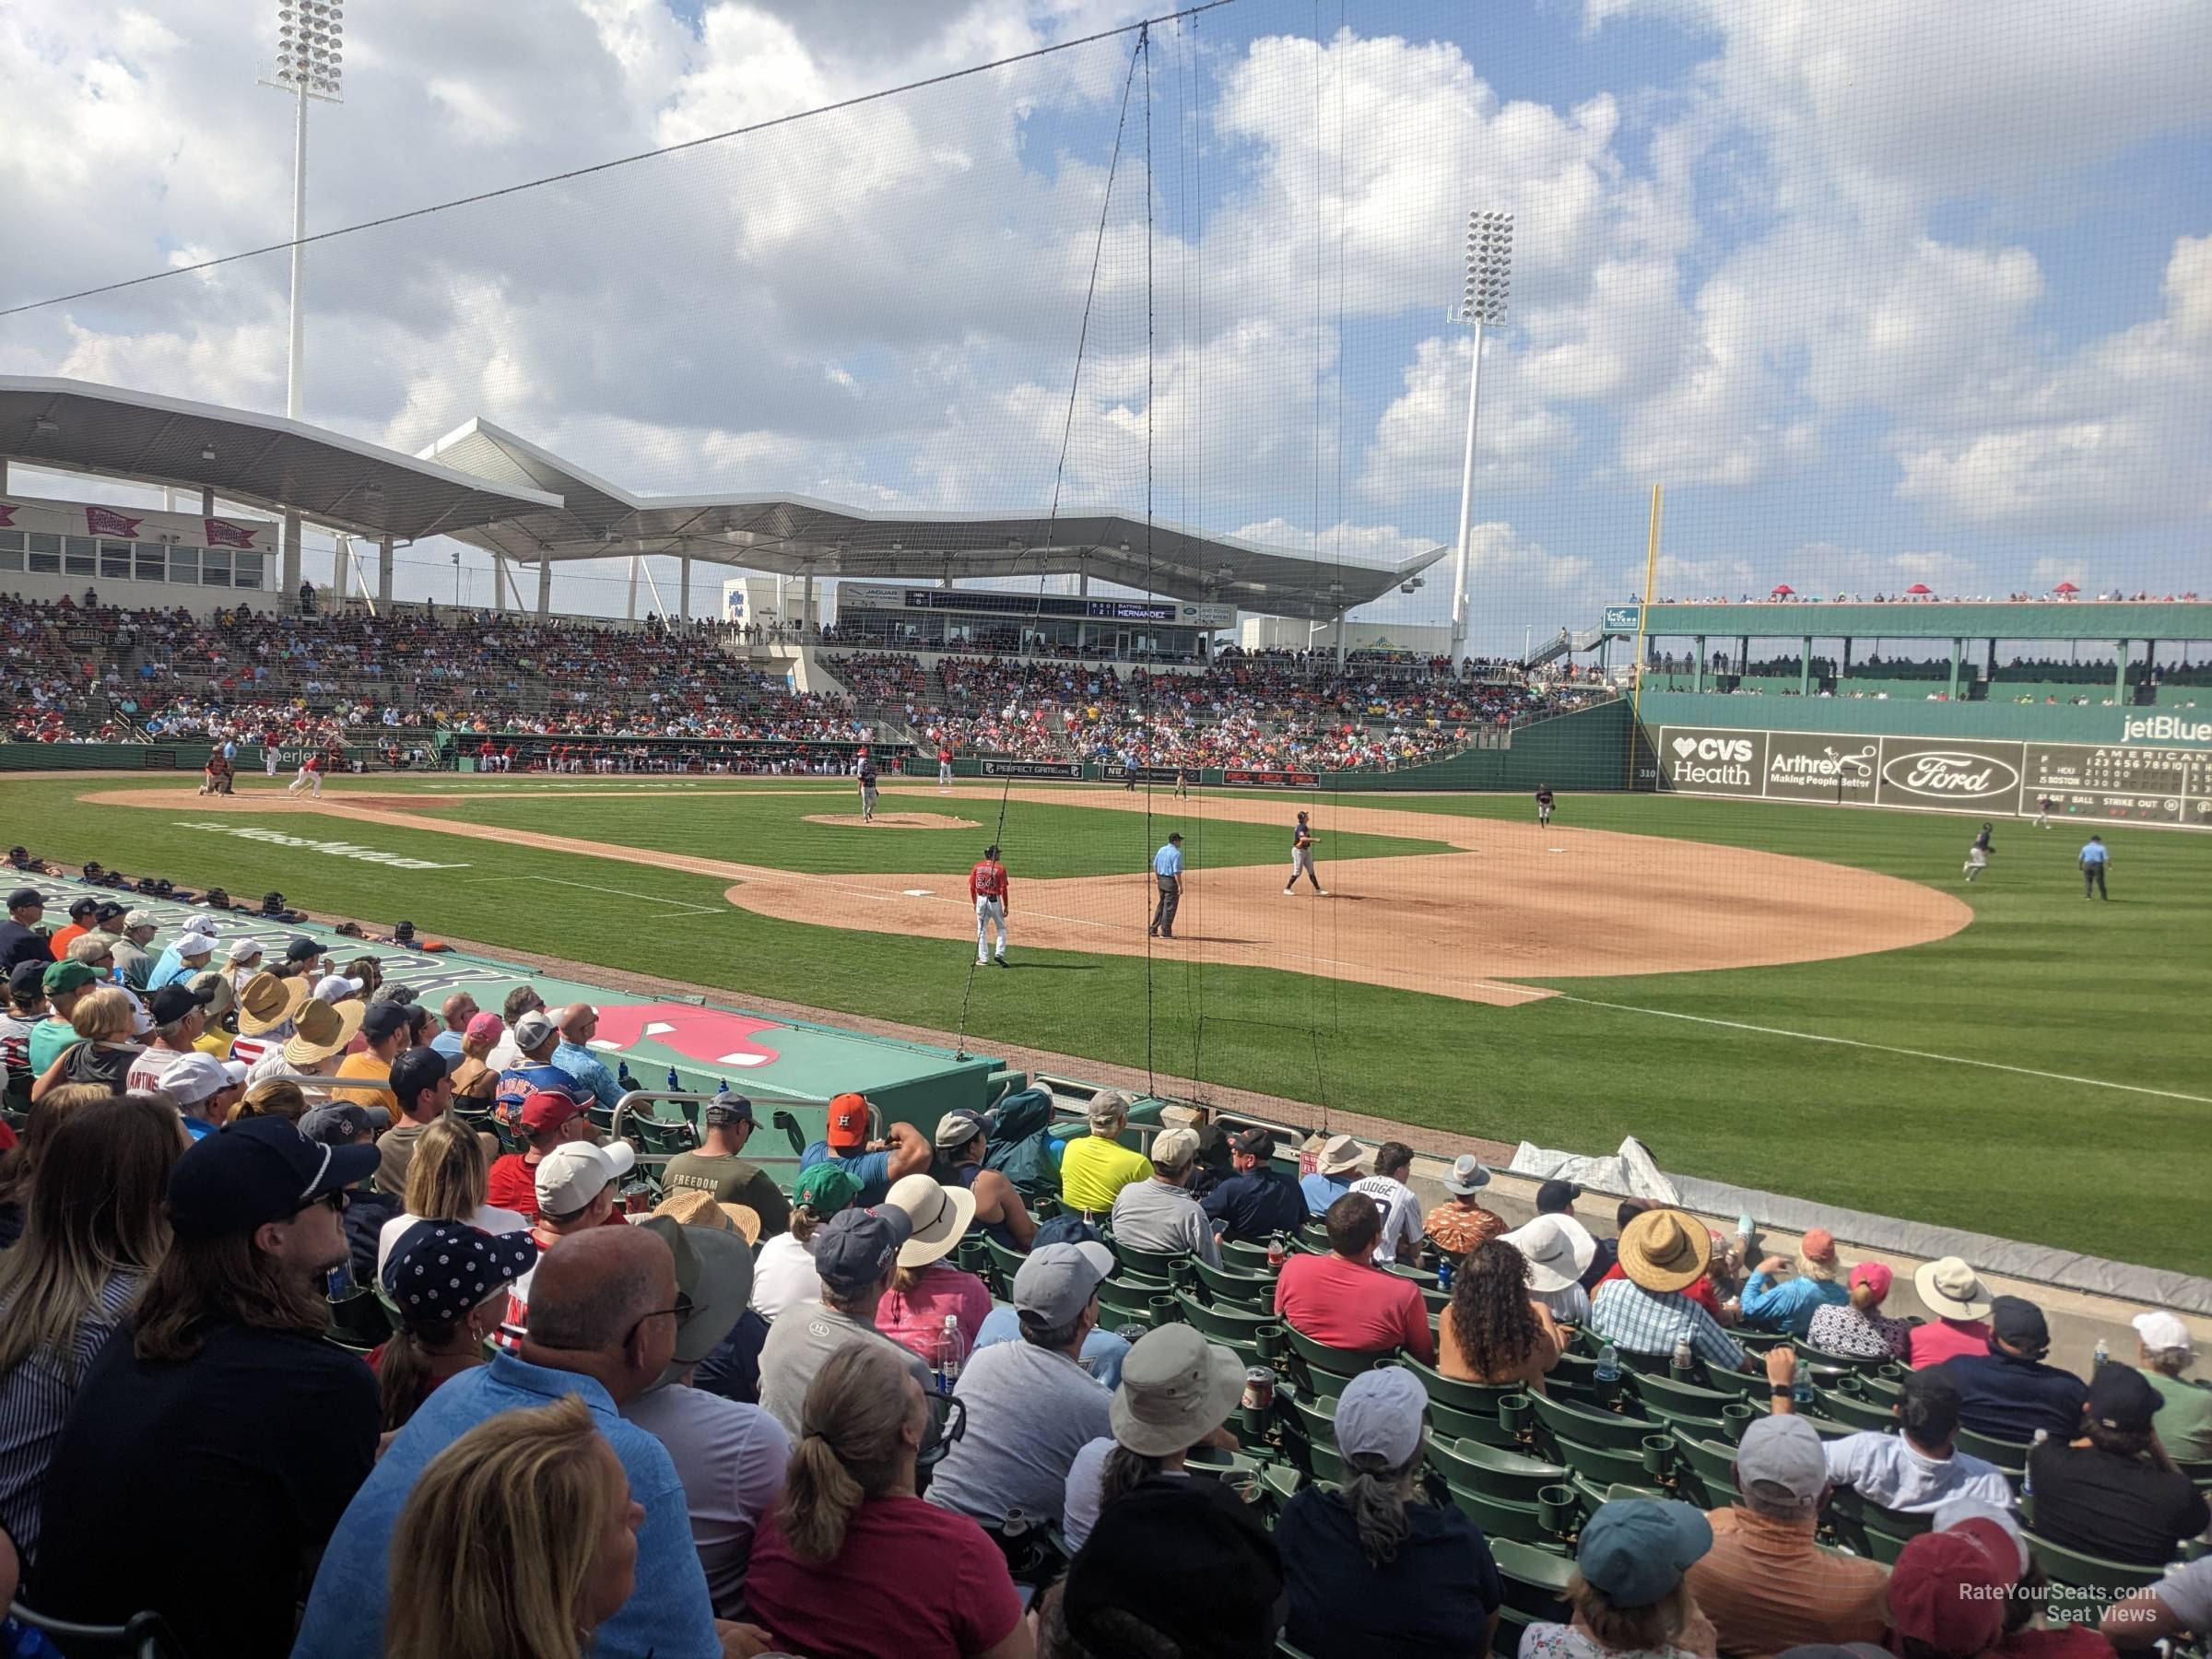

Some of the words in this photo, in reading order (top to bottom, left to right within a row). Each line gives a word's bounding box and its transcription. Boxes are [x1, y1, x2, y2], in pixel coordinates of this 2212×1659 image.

[1118, 609, 1165, 618] HERNANDEZ
[2121, 715, 2212, 742] jetBlue
[1699, 737, 1753, 761] CVS
[2094, 748, 2208, 762] AMERICAN
[996, 765, 1032, 773] PERFECT
[1771, 753, 1843, 775] Arthrex
[2056, 767, 2076, 775] HOU
[1640, 769, 1656, 778] 310
[1673, 760, 1751, 785] Health
[1907, 757, 1993, 792] Ford
[1771, 773, 1805, 786] Making
[1806, 775, 1838, 787] People
[1841, 778, 1870, 788] Better
[2048, 776, 2080, 785] BOSTON
[2071, 796, 2094, 805] BALL
[2102, 797, 2135, 806] STRIKE
[2137, 800, 2159, 808] OUT
[126, 1071, 160, 1093] ARTINE
[840, 1115, 850, 1126] H
[674, 1173, 719, 1191] FREEDOM
[1359, 1181, 1398, 1197] JUDGE
